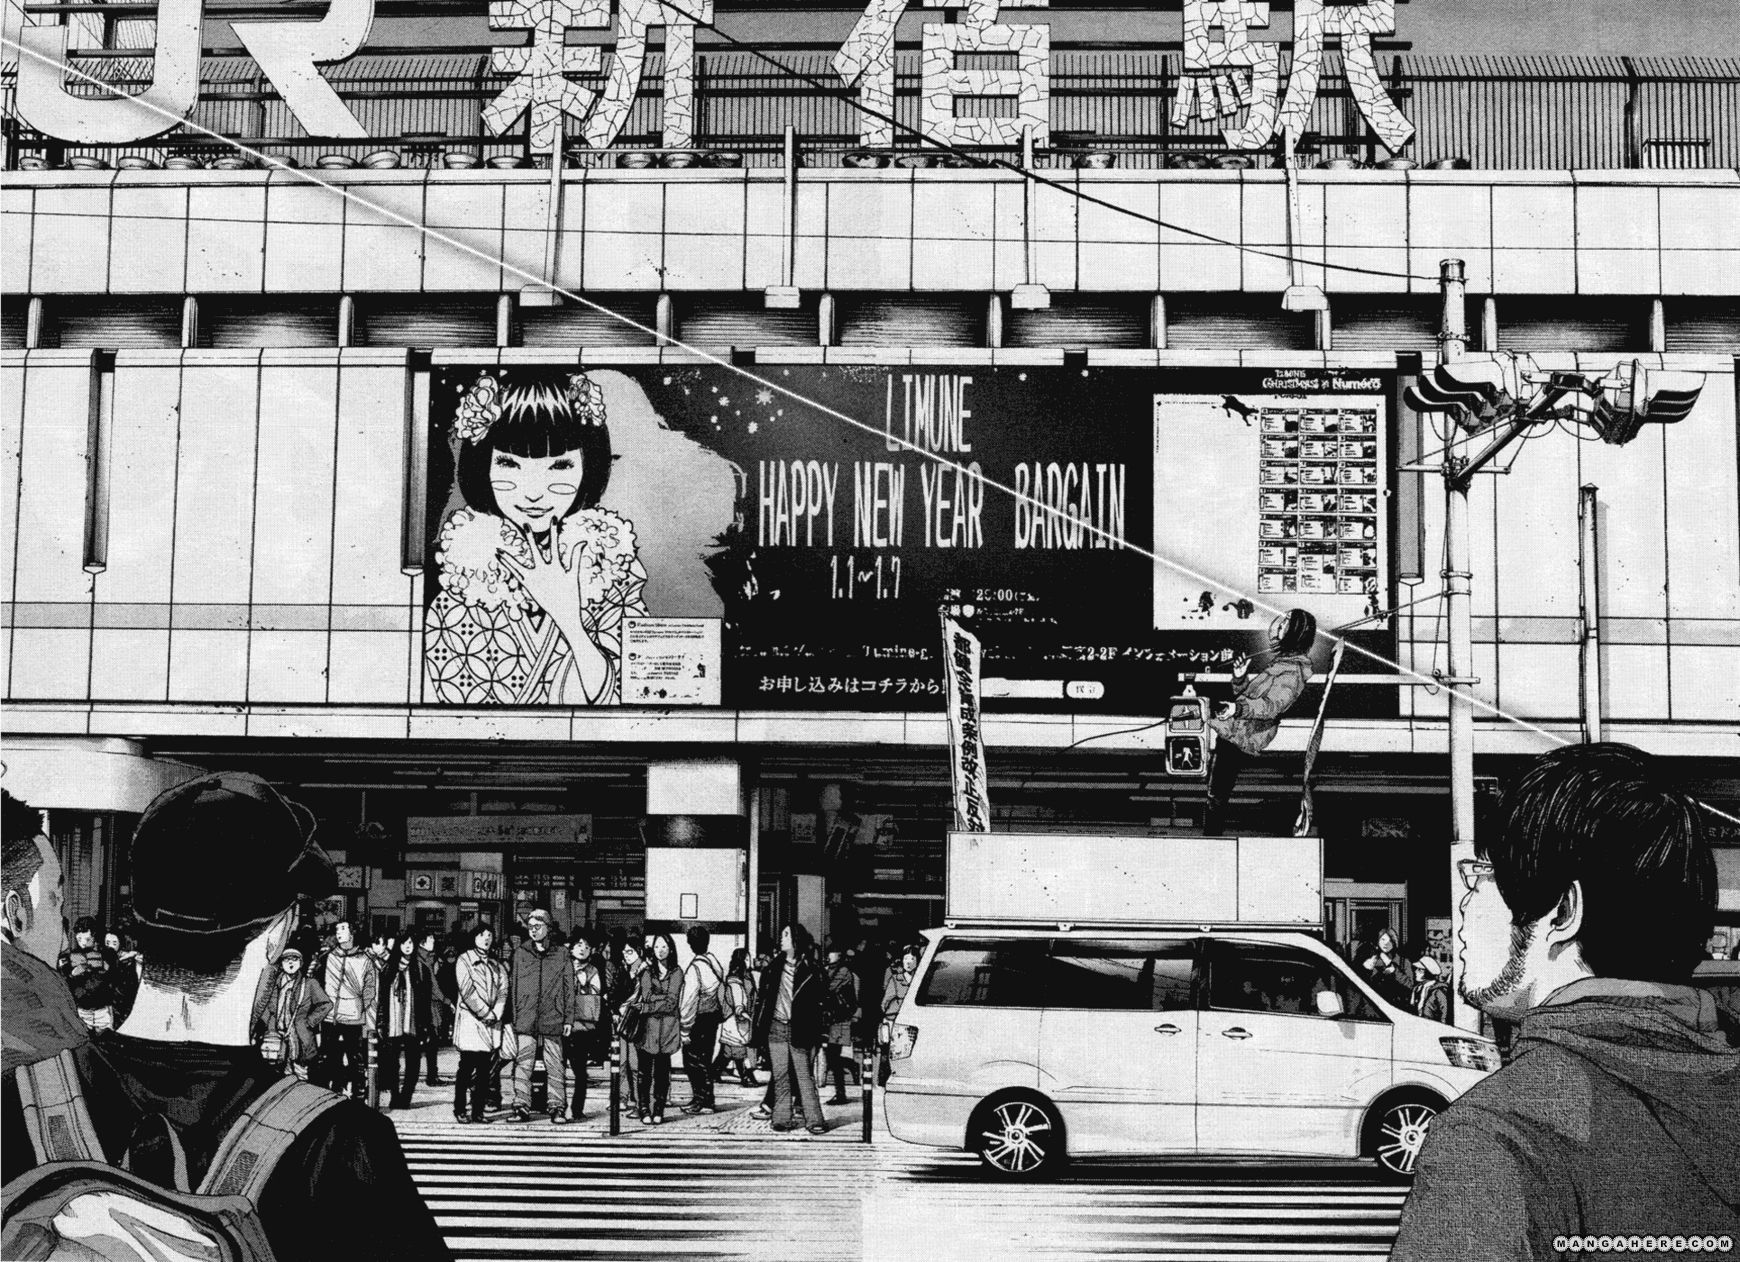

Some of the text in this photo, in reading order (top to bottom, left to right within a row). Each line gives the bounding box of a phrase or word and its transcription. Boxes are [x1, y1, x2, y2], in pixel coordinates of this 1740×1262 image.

[886, 373, 973, 453] LIMUNE
[758, 459, 1126, 551] HAPPY NEW YEAR BARGAIN
